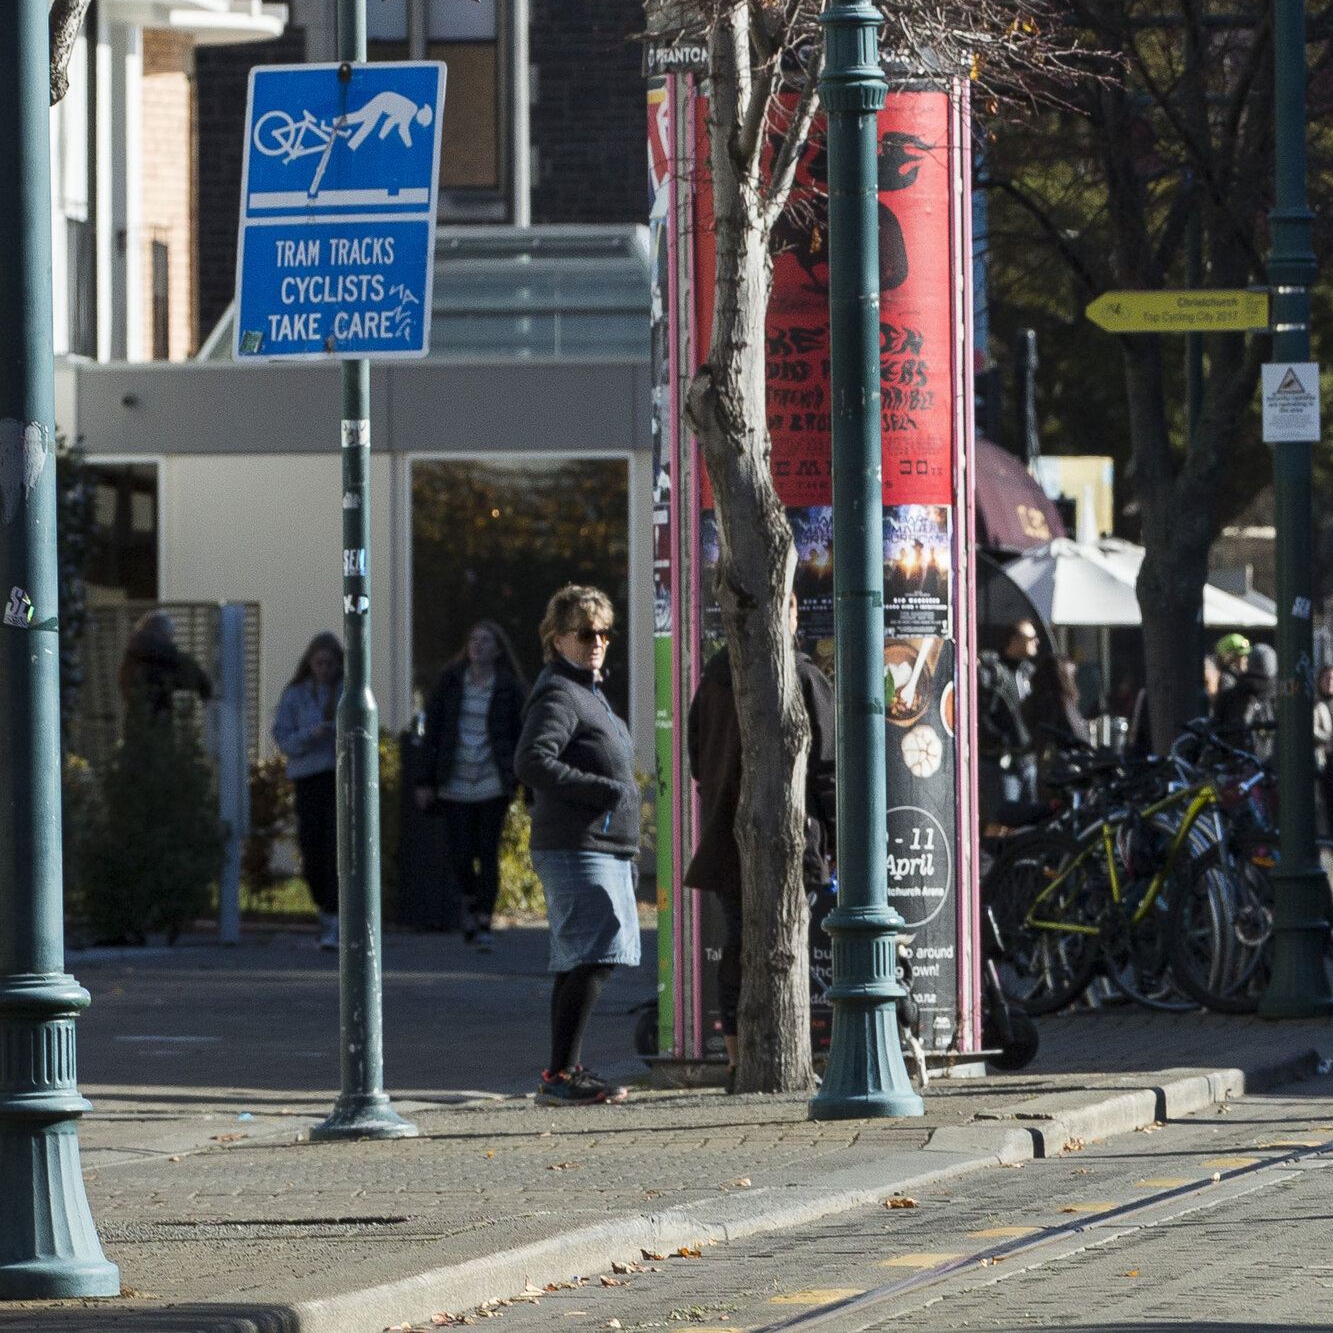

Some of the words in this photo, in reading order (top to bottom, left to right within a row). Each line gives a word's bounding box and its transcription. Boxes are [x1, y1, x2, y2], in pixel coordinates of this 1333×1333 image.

[276, 239, 320, 267] TRAM
[330, 237, 394, 266] TRACKS
[282, 275, 384, 304] CYCLISTS
[269, 313, 321, 341] TAKE
[334, 311, 392, 339] CARE
[909, 827, 935, 850] 11
[886, 853, 935, 881] April
[887, 886, 921, 897] tchurch
[915, 945, 954, 960] around
[912, 964, 940, 977] own!
